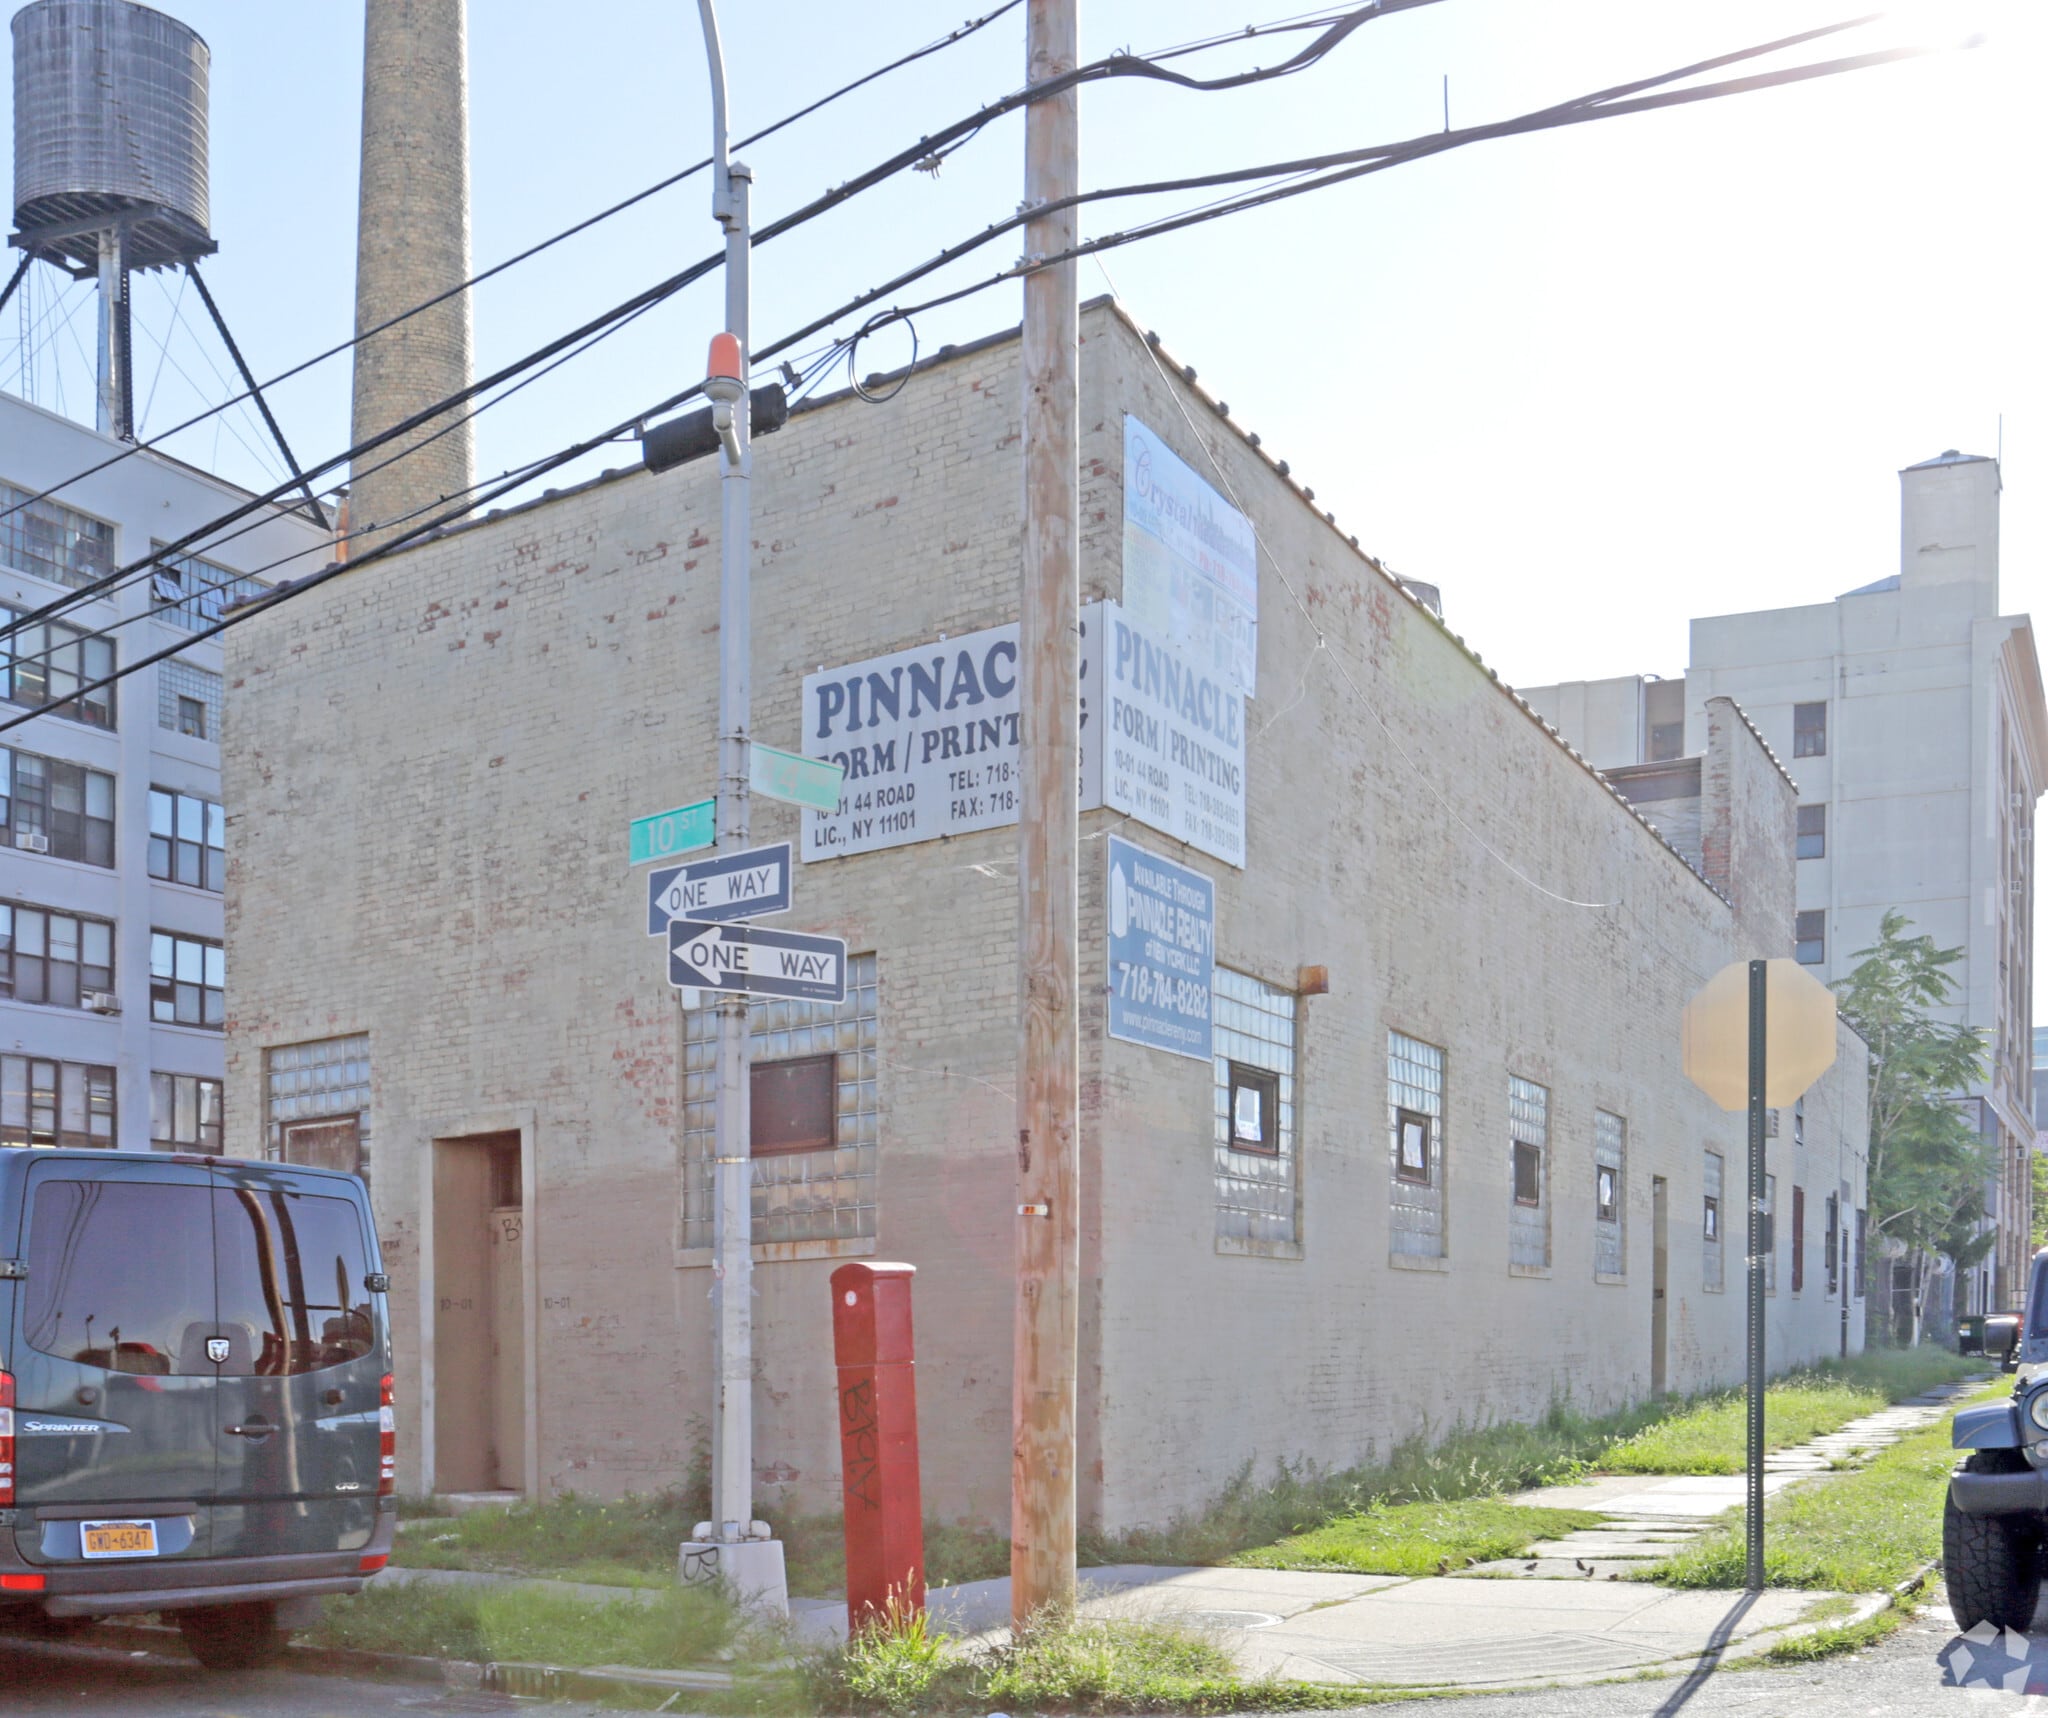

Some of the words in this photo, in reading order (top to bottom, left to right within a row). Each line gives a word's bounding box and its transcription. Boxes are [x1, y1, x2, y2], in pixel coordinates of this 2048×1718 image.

[1131, 435, 1193, 531] Crystal
[816, 621, 1087, 738] PINNAC
[1115, 620, 1239, 750] PINNACLE
[1113, 696, 1159, 753] FORM
[1170, 728, 1240, 796] PRINTING
[950, 771, 980, 791] TEL:
[1114, 748, 1135, 775] 10-01
[1148, 765, 1169, 792] ROAD
[855, 795, 872, 812] 44
[877, 783, 915, 807] ROAD
[951, 799, 983, 820] FAX:
[1136, 787, 1147, 809] NY
[1150, 794, 1169, 820] 11101
[647, 816, 676, 855] 10
[680, 809, 698, 830] ST
[815, 826, 846, 847] LIC.,
[852, 819, 873, 839] NY
[879, 810, 916, 833] 11101
[670, 882, 708, 912] ONE
[728, 868, 771, 901] WAY
[1128, 886, 1174, 944] PINNACLE
[1176, 907, 1212, 958] REALTY
[690, 942, 749, 971] ONE
[780, 951, 830, 980] WAY
[24, 1421, 100, 1432] SPRINTER
